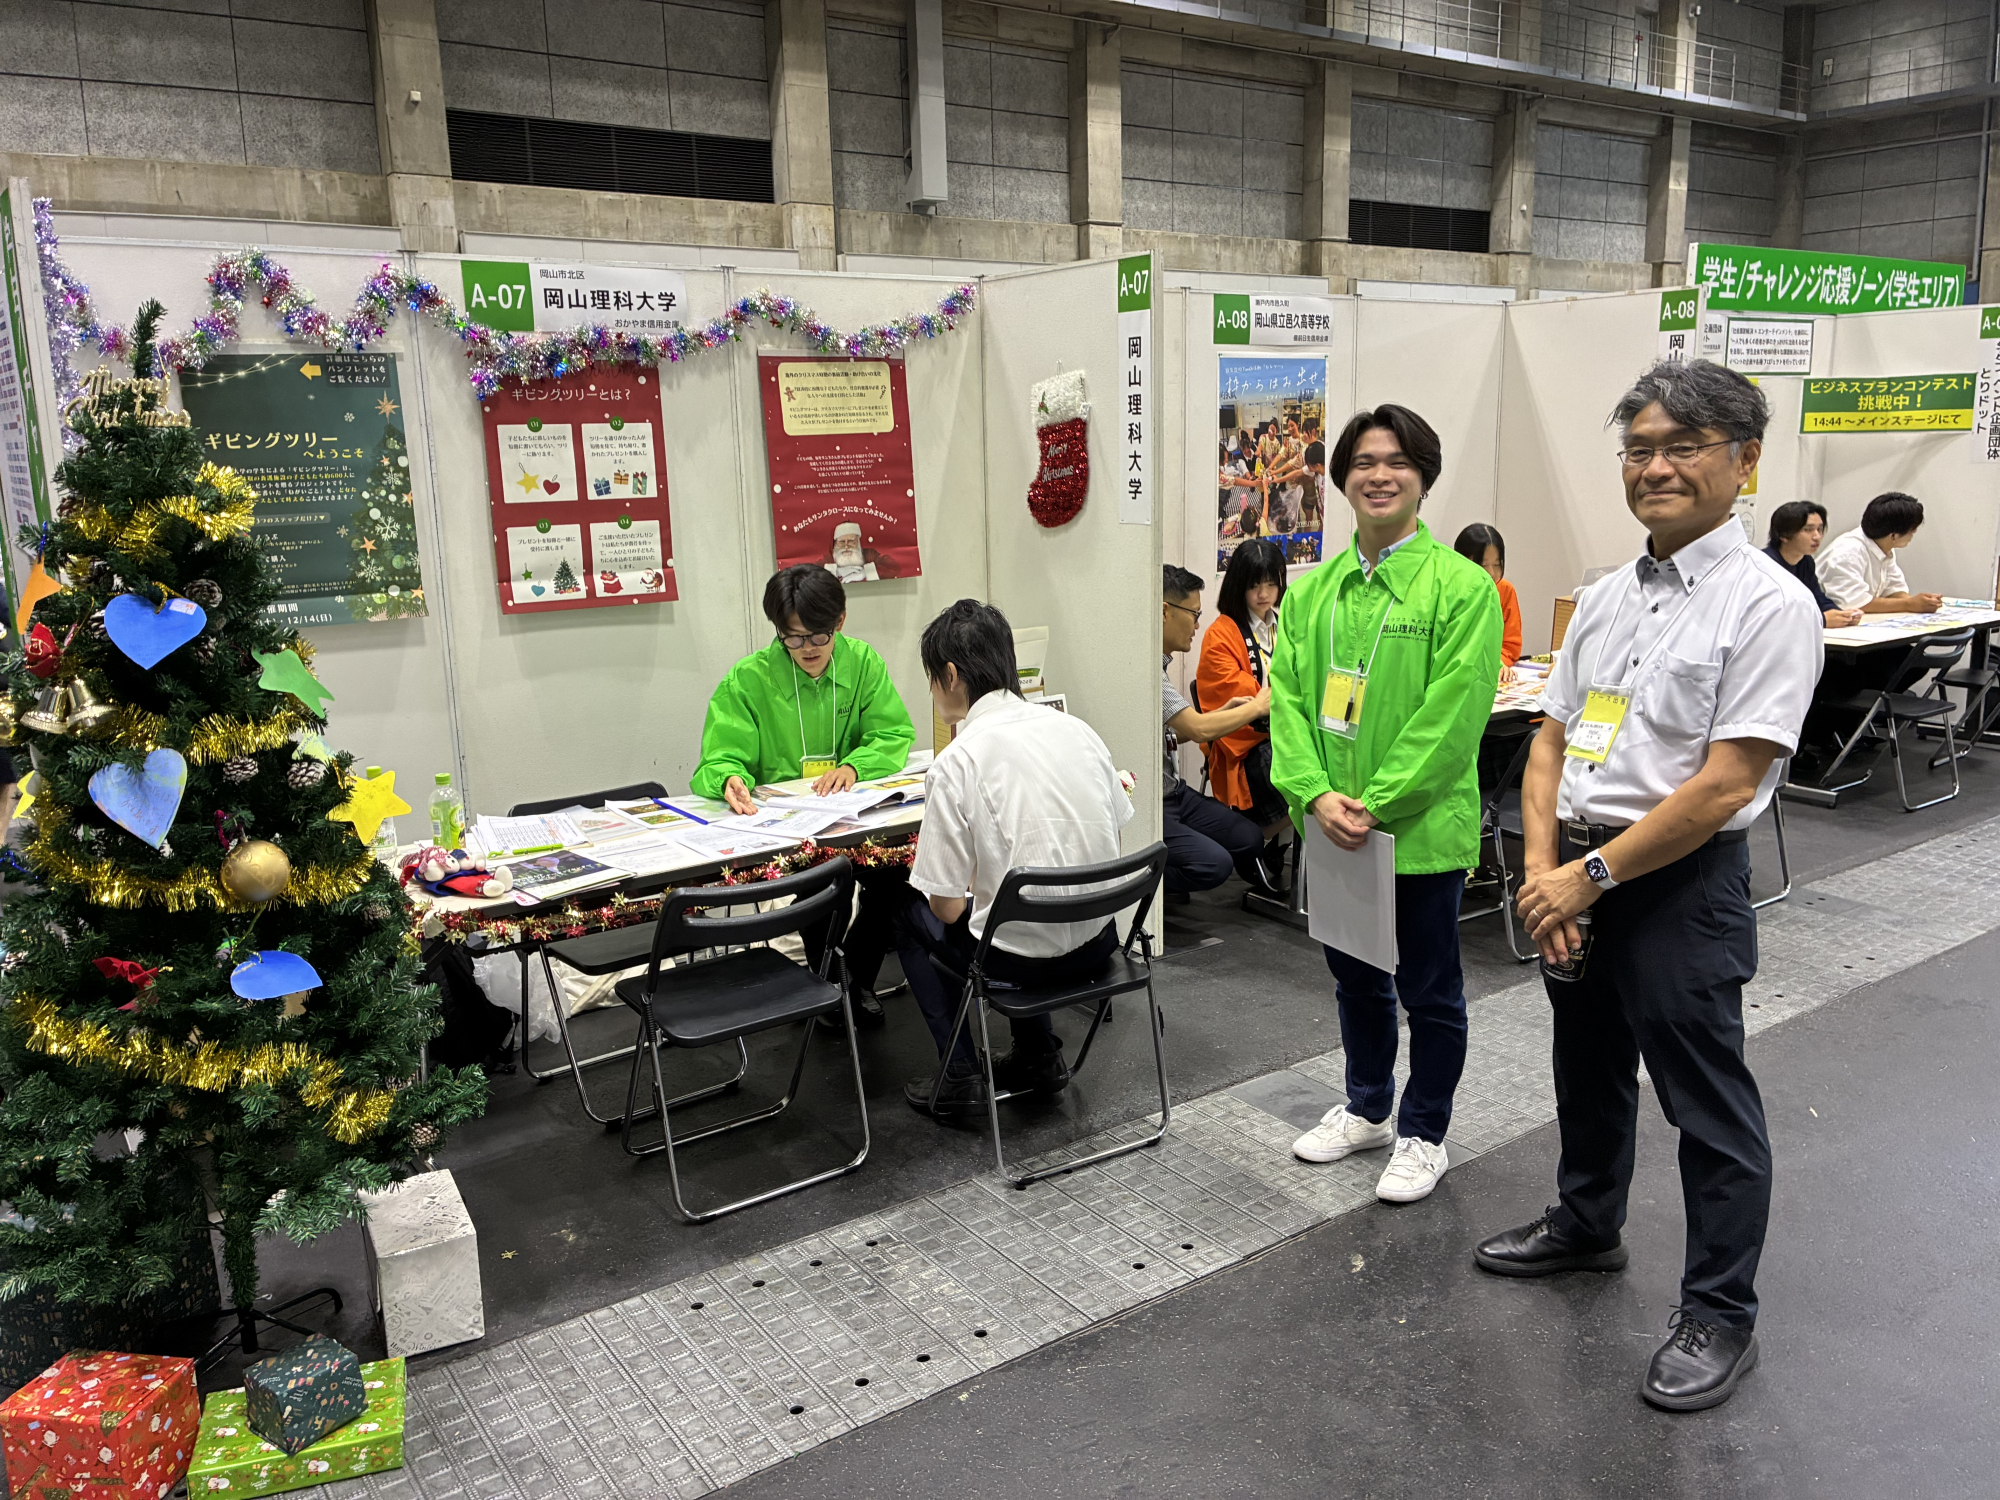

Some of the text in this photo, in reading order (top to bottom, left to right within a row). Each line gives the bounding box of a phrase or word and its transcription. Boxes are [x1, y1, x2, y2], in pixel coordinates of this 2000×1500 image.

[540, 269, 586, 280] 岡山市北区
[1120, 270, 1149, 297] A-07
[1702, 255, 1960, 308] 学生/チャレンジ応援ゾーン(学生エリア)
[471, 283, 526, 309] A-07
[543, 288, 677, 312] 岡山理科大学
[1217, 309, 1248, 329] A-08
[1662, 300, 1695, 320] A-08
[614, 318, 680, 329] おかやま信用金庫
[1254, 312, 1330, 330] 岡山県立邑久高等学校
[325, 355, 386, 363] 詳細はこちらの
[327, 365, 387, 373] パンフレットを
[329, 375, 387, 384] ご覧ください！
[1809, 377, 1973, 395] ビジネスプランコンテスト
[511, 388, 631, 401] ギビングツリーとは？
[1857, 394, 1923, 411] 挑戦中！
[1976, 367, 1991, 435] とりドット
[1127, 336, 1143, 501] 岡山理科大学
[204, 432, 338, 450] ギビングツリー
[303, 448, 364, 459] へようこそ
[1590, 691, 1627, 706] ブース出展
